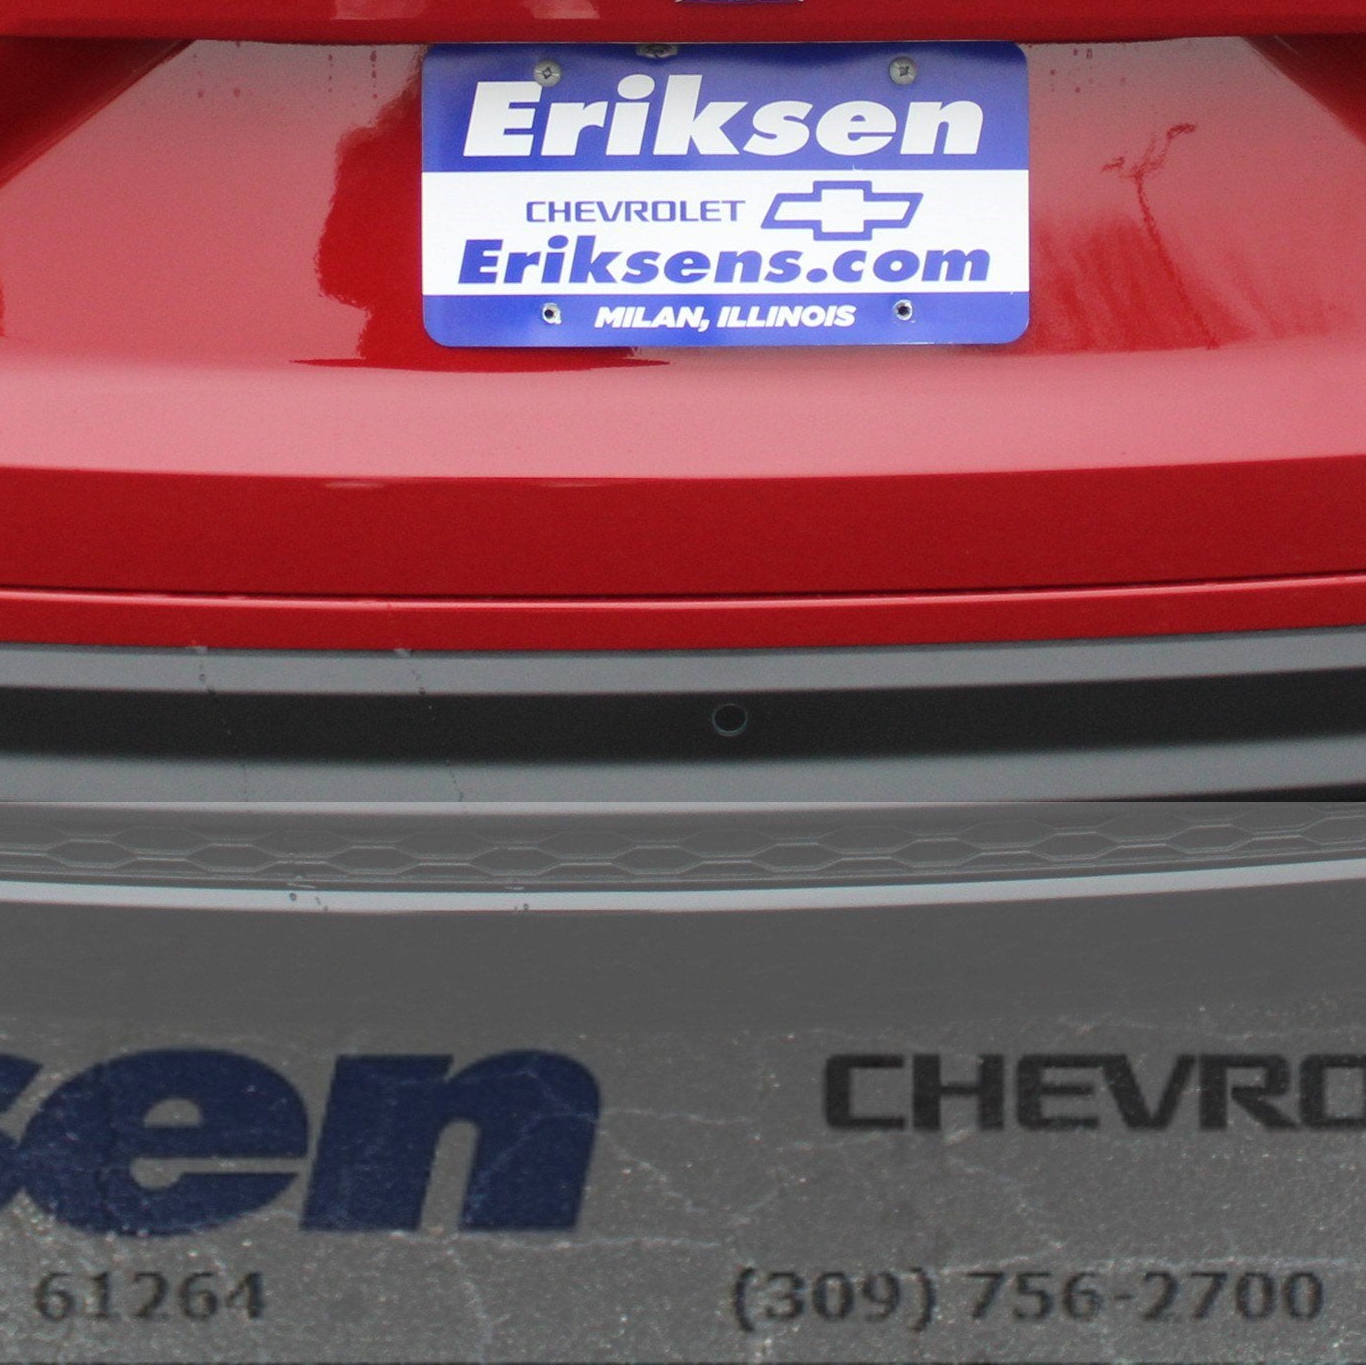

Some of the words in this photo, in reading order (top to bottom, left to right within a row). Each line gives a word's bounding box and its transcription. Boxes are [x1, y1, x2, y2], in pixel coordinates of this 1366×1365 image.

[463, 74, 984, 157] Eriksen
[525, 199, 746, 223] CHEVROLET
[458, 235, 990, 285] Eriksens.com
[594, 304, 710, 333] MILAN,
[716, 304, 857, 328] ILLINOIS
